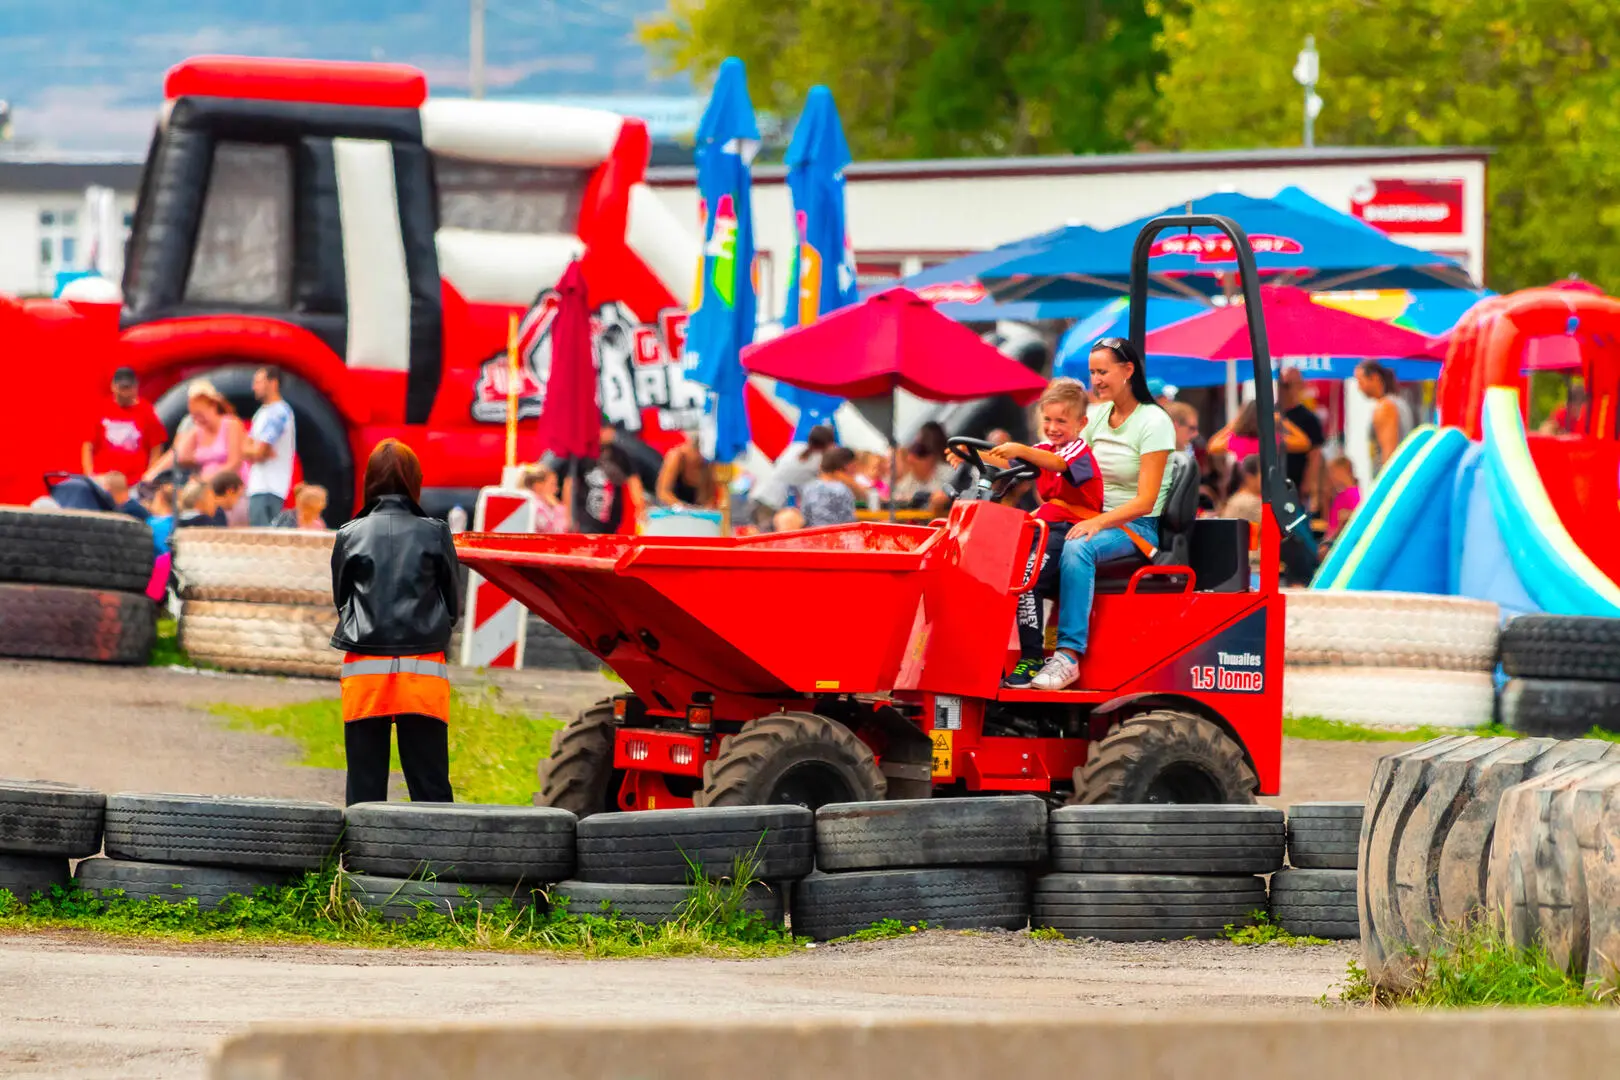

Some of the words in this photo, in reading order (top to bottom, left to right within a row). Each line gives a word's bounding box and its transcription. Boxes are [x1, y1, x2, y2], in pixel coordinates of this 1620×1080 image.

[1217, 651, 1262, 666] Thwaites
[1190, 665, 1216, 690] 1.5
[1217, 666, 1263, 691] tonne
